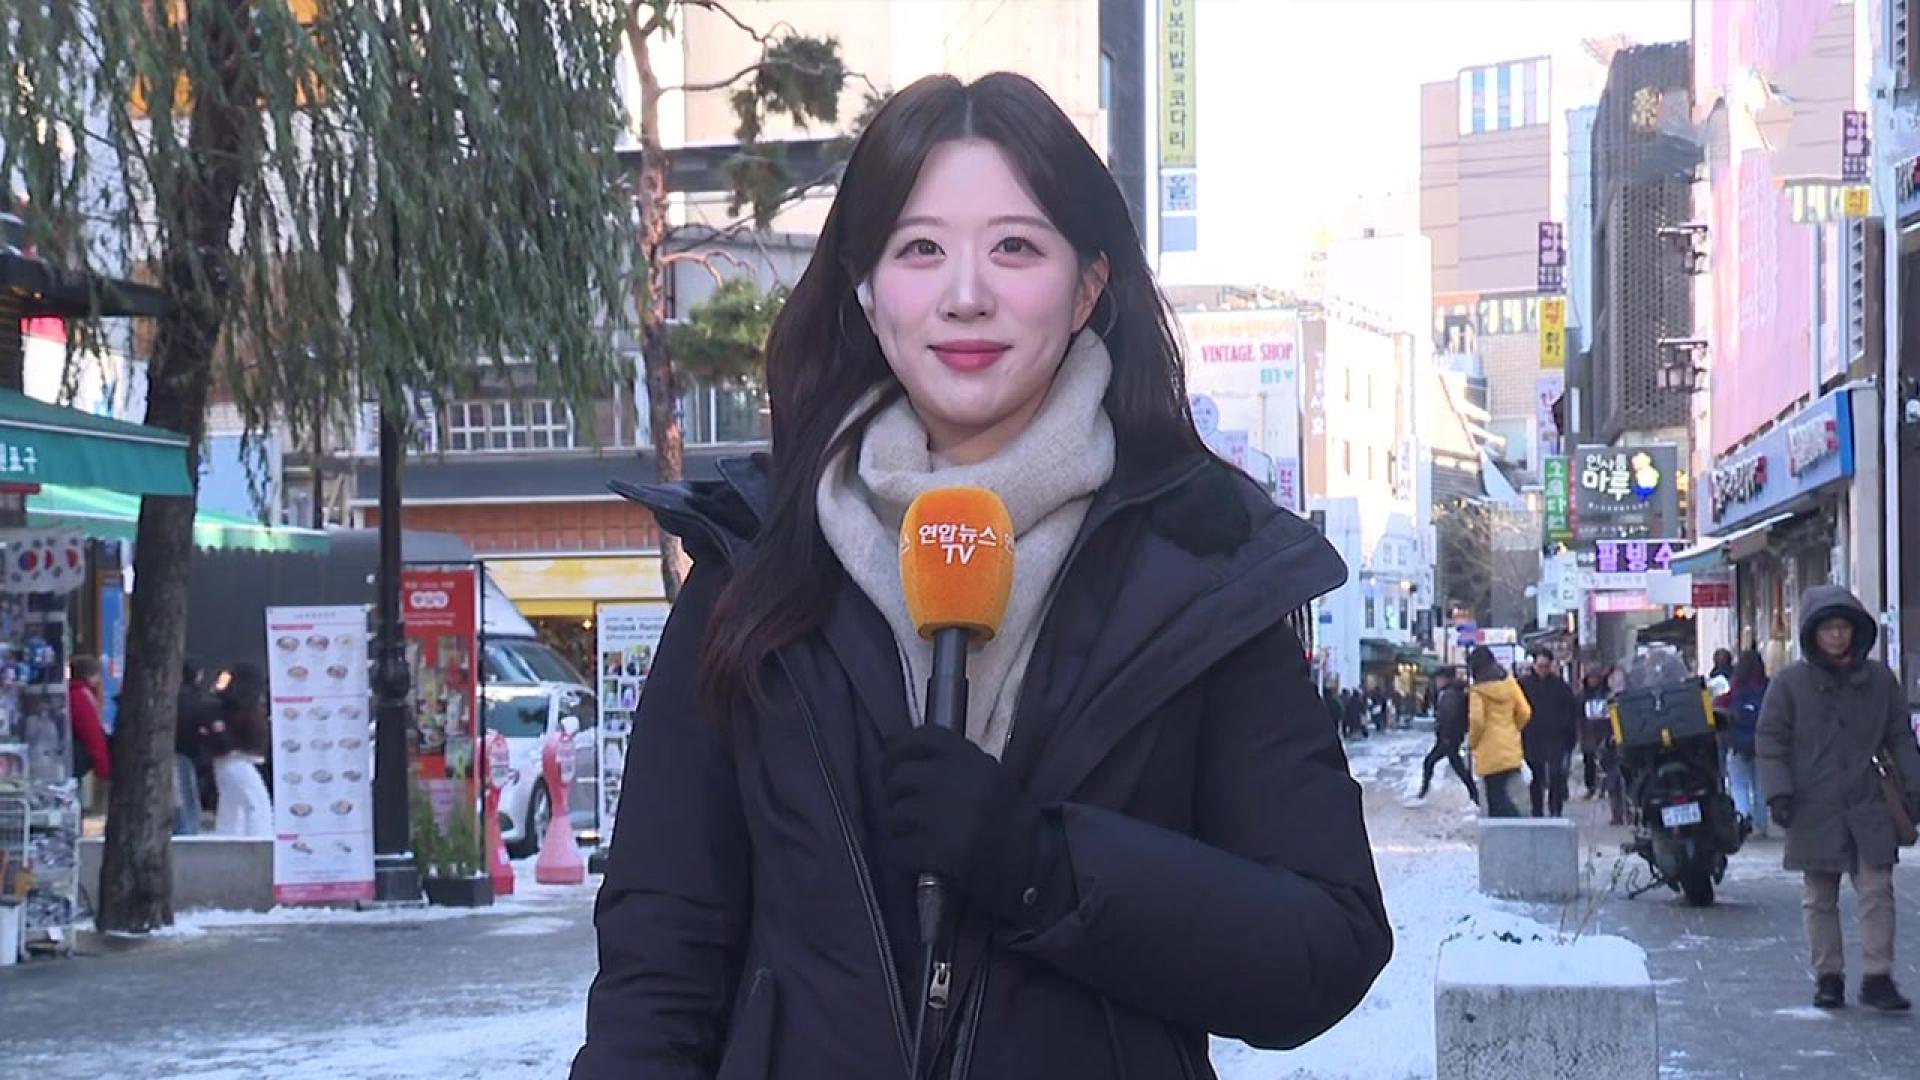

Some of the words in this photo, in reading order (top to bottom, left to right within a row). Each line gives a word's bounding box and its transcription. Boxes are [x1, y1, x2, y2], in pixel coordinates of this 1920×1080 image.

[1201, 344, 1255, 362] VINTAGE
[1260, 343, 1293, 361] SHOP
[1582, 470, 1631, 501] 마루
[918, 523, 997, 547] 연합뉴스
[941, 543, 976, 564] TV
